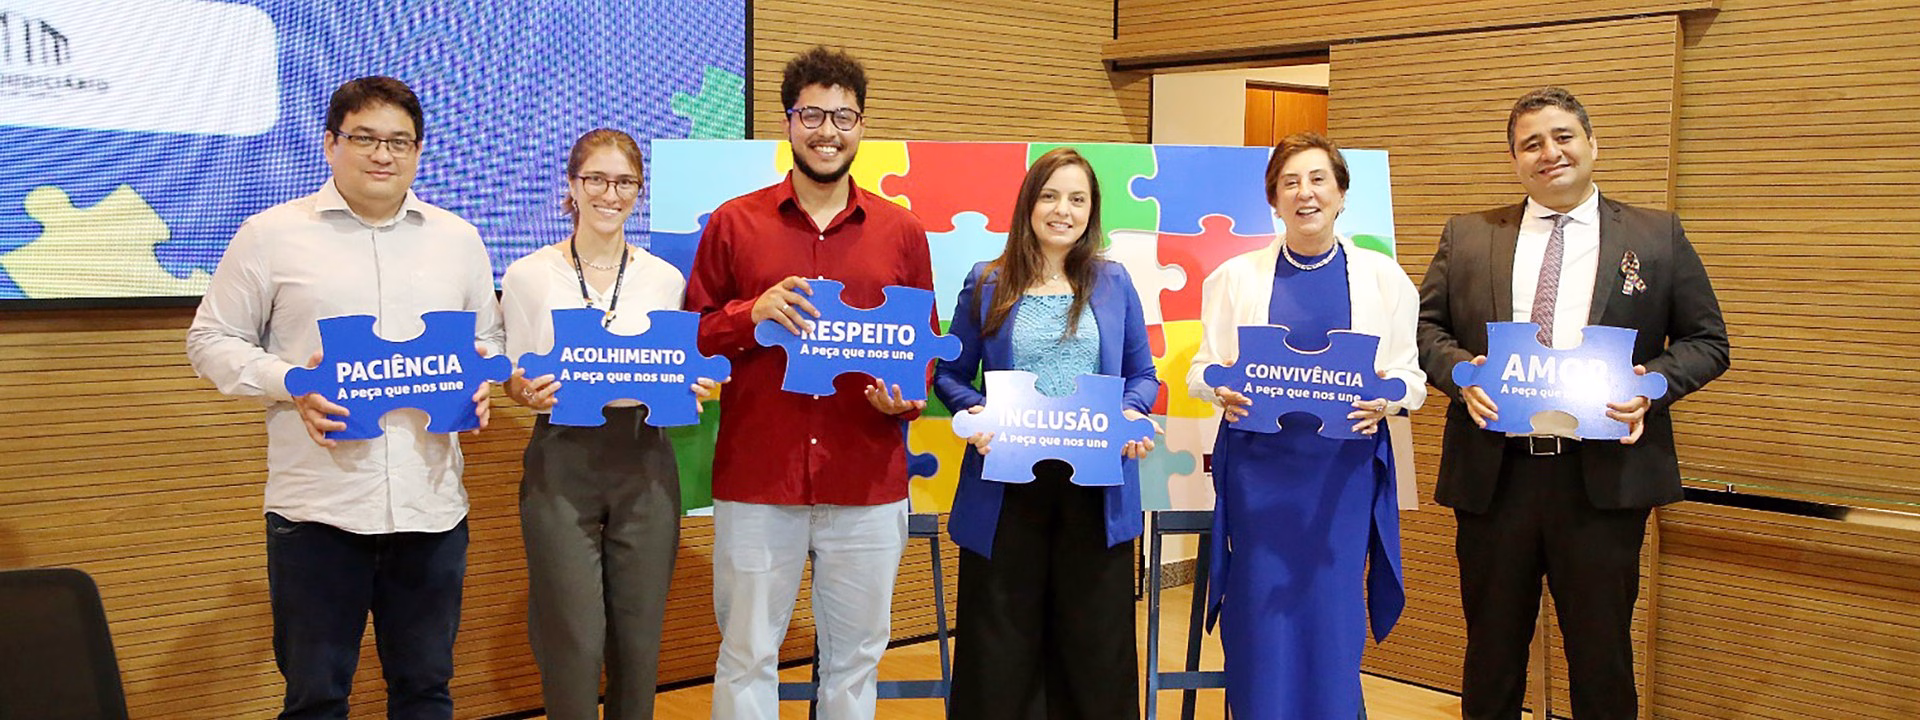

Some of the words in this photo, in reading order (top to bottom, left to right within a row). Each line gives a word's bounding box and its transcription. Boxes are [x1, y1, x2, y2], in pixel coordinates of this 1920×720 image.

[801, 319, 916, 346] RESPEITO
[560, 346, 686, 365] ACOLHIMENTO
[800, 343, 809, 355] A
[812, 346, 839, 359] peça
[842, 348, 865, 359] que
[867, 349, 889, 358] nos
[892, 350, 914, 360] une
[336, 353, 463, 383] PACIÊNCIA
[560, 368, 571, 381] A
[573, 371, 604, 384] peça
[606, 372, 631, 384] que
[634, 373, 658, 382] nos
[660, 374, 685, 383] une
[1245, 363, 1363, 388] CONVIVÊNCIA
[337, 387, 348, 400] A
[350, 387, 382, 401] peça
[385, 385, 410, 398] que
[413, 383, 437, 394] nos
[439, 381, 464, 391] une
[1243, 382, 1253, 393] A
[1256, 385, 1284, 398] peça
[1286, 388, 1310, 399] que
[1312, 390, 1335, 400] nos
[1338, 392, 1361, 402] une
[1501, 383, 1509, 394] A
[1512, 387, 1537, 398] peça
[1540, 388, 1561, 398] que
[999, 407, 1109, 432] INCLUSÃO
[998, 431, 1007, 443] A
[1010, 434, 1036, 447] peça
[1039, 436, 1061, 447] que
[1063, 437, 1084, 447] nos
[1087, 439, 1108, 449] une
